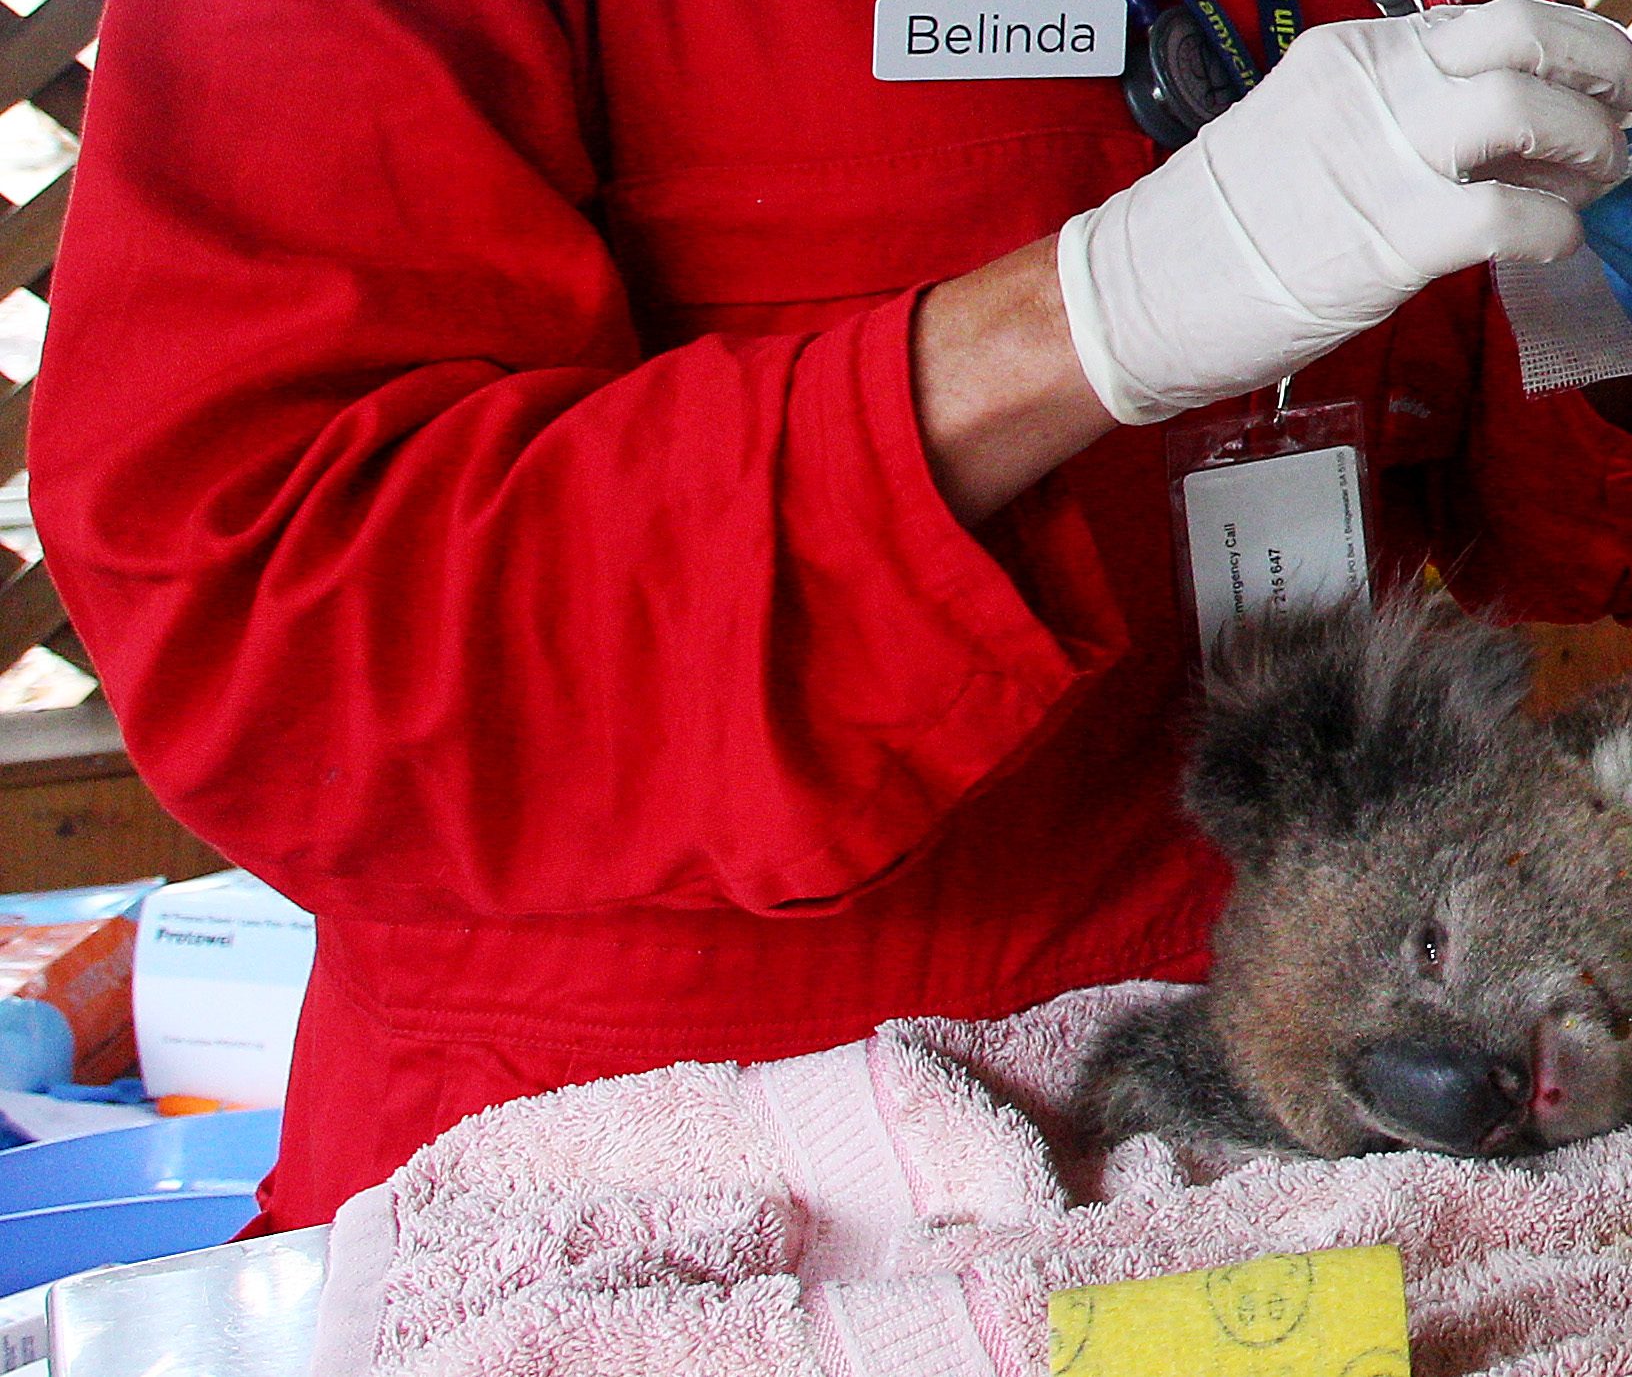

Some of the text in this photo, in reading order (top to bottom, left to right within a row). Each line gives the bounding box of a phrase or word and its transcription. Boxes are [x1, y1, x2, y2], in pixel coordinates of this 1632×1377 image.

[907, 13, 1096, 54] Belinda
[1223, 522, 1245, 616] mergency Call
[1268, 548, 1283, 575] 647
[1272, 577, 1287, 604] 215
